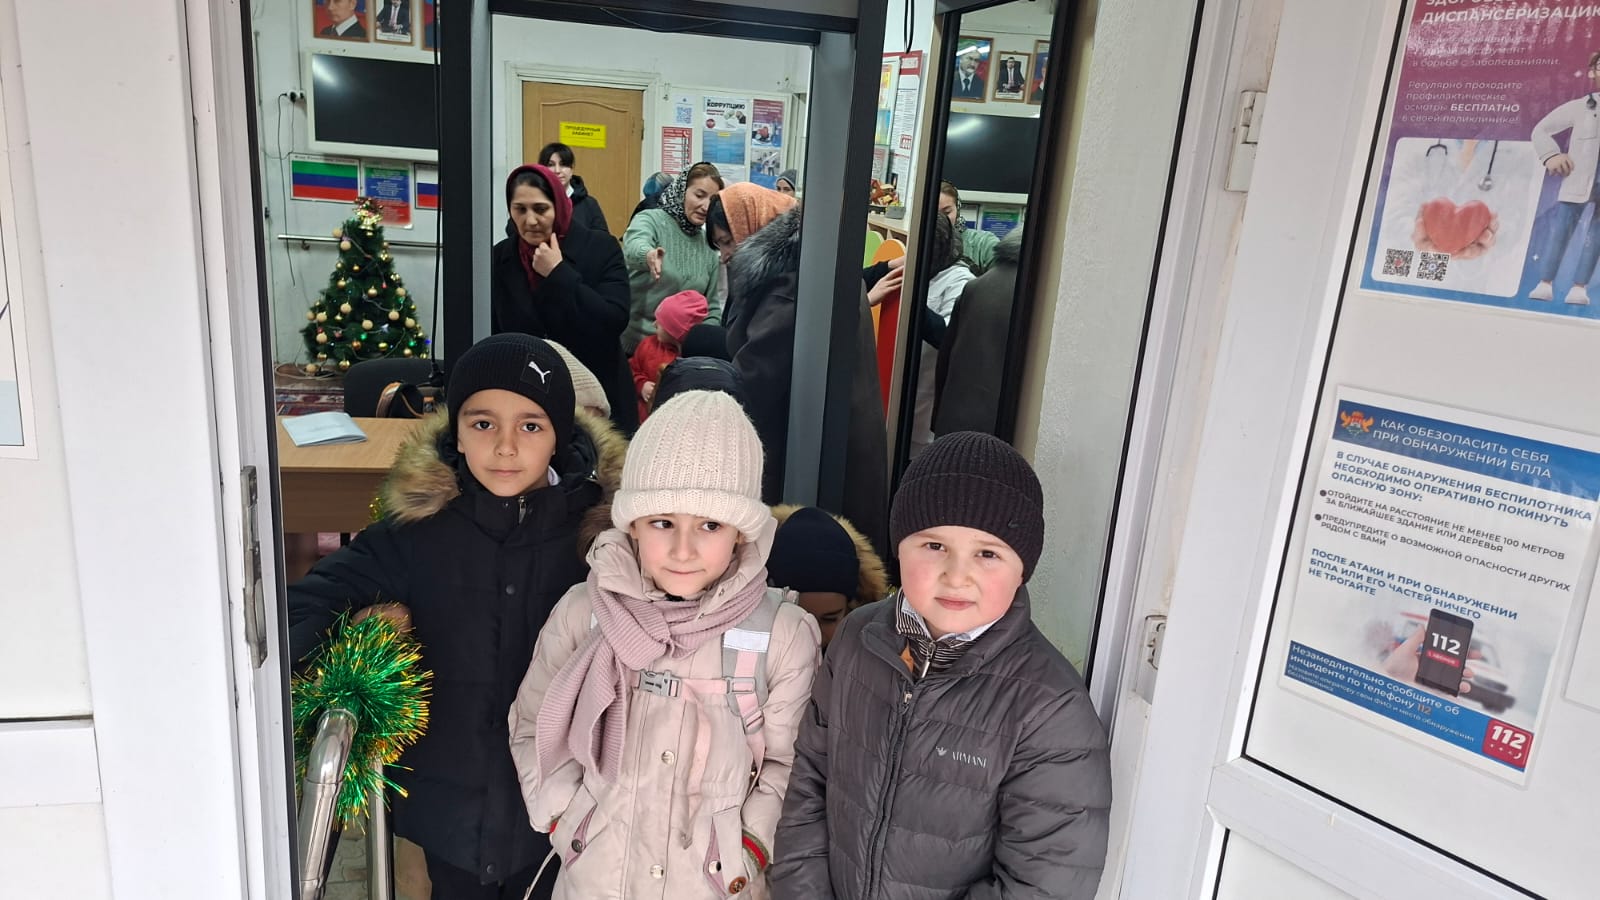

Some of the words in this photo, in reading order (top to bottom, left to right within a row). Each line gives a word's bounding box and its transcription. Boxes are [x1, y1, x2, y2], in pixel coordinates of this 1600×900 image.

[1406, 93, 1507, 101] профилактические
[1408, 81, 1463, 90] Регулярно
[1465, 81, 1522, 90] проходите
[1450, 103, 1520, 112] БЕСПЛАТНО
[1373, 430, 1400, 443] ПРИ
[1402, 437, 1507, 468] ОБНАРУЖЕНИИ
[1511, 461, 1552, 479] БПЛА
[1381, 419, 1405, 432] КАК
[1408, 425, 1508, 454] ОБЕЗОПАСИТЬ
[1511, 447, 1549, 464] СЕБЯ
[1331, 472, 1386, 493] ОПАСНУЮ
[1389, 487, 1423, 502] ЗОНУ:
[1334, 461, 1411, 488] НЕОБХОДИМО
[1414, 482, 1495, 509] ОПЕРАТИВНО
[1498, 503, 1569, 528] ПОКИНУТЬ
[1336, 451, 1344, 459] В
[1346, 453, 1390, 471] СЛУЧАЕ
[1392, 465, 1482, 494] ОБНАРУЖЕНИЯ
[1485, 488, 1592, 521] БЕСПИЛОТНИКА
[1321, 521, 1351, 536] РЯДОМ
[1360, 533, 1386, 547] ВАМИ
[1325, 498, 1336, 506] ЗА
[1338, 501, 1394, 522] БЛИЖАЙШЕЕ
[1396, 517, 1433, 533] ЗДАНИЕ
[1436, 529, 1456, 540] ИЛИ
[1458, 534, 1503, 553] ДЕРЕВЬЯ
[1327, 489, 1373, 508] ОТОЙДИТЕ
[1375, 501, 1387, 511] НА
[1389, 506, 1449, 529] РАССТОЯНИЕ
[1452, 522, 1465, 533] НЕ
[1467, 528, 1501, 543] МЕНЕЕ
[1503, 537, 1519, 548] 100
[1521, 543, 1565, 560] МЕТРОВ
[1322, 513, 1389, 539] ПРЕДУПРЕДИТЕ
[1400, 536, 1462, 560] ВОЗМОЖНОЙ
[1464, 555, 1527, 579] ОПАСНОСТИ
[1528, 574, 1571, 592] ДРУГИХ
[1308, 567, 1322, 578] НЕ
[1324, 572, 1376, 596] ТРОГАЙТЕ
[1310, 558, 1338, 573] БПЛА
[1341, 568, 1363, 581] ИЛИ
[1366, 576, 1386, 588] ЕГО
[1388, 583, 1432, 604] ЧАСТЕЙ
[1435, 599, 1481, 620] НИЧЕГО
[1312, 548, 1347, 565] ПОСЛЕ
[1349, 560, 1384, 577] АТАКИ
[1387, 572, 1395, 581] И
[1398, 575, 1421, 589] ПРИ
[1424, 584, 1518, 620] ОБНАРУЖЕНИИ
[1432, 632, 1460, 655] 112
[1290, 654, 1345, 681] инциденте
[1347, 677, 1360, 687] по
[1362, 682, 1415, 709] телефону
[1417, 703, 1432, 715] 112
[1292, 643, 1385, 686] Незамедлительно
[1386, 682, 1442, 708] сообщите
[1444, 705, 1460, 715] об
[1491, 725, 1527, 750] 112
